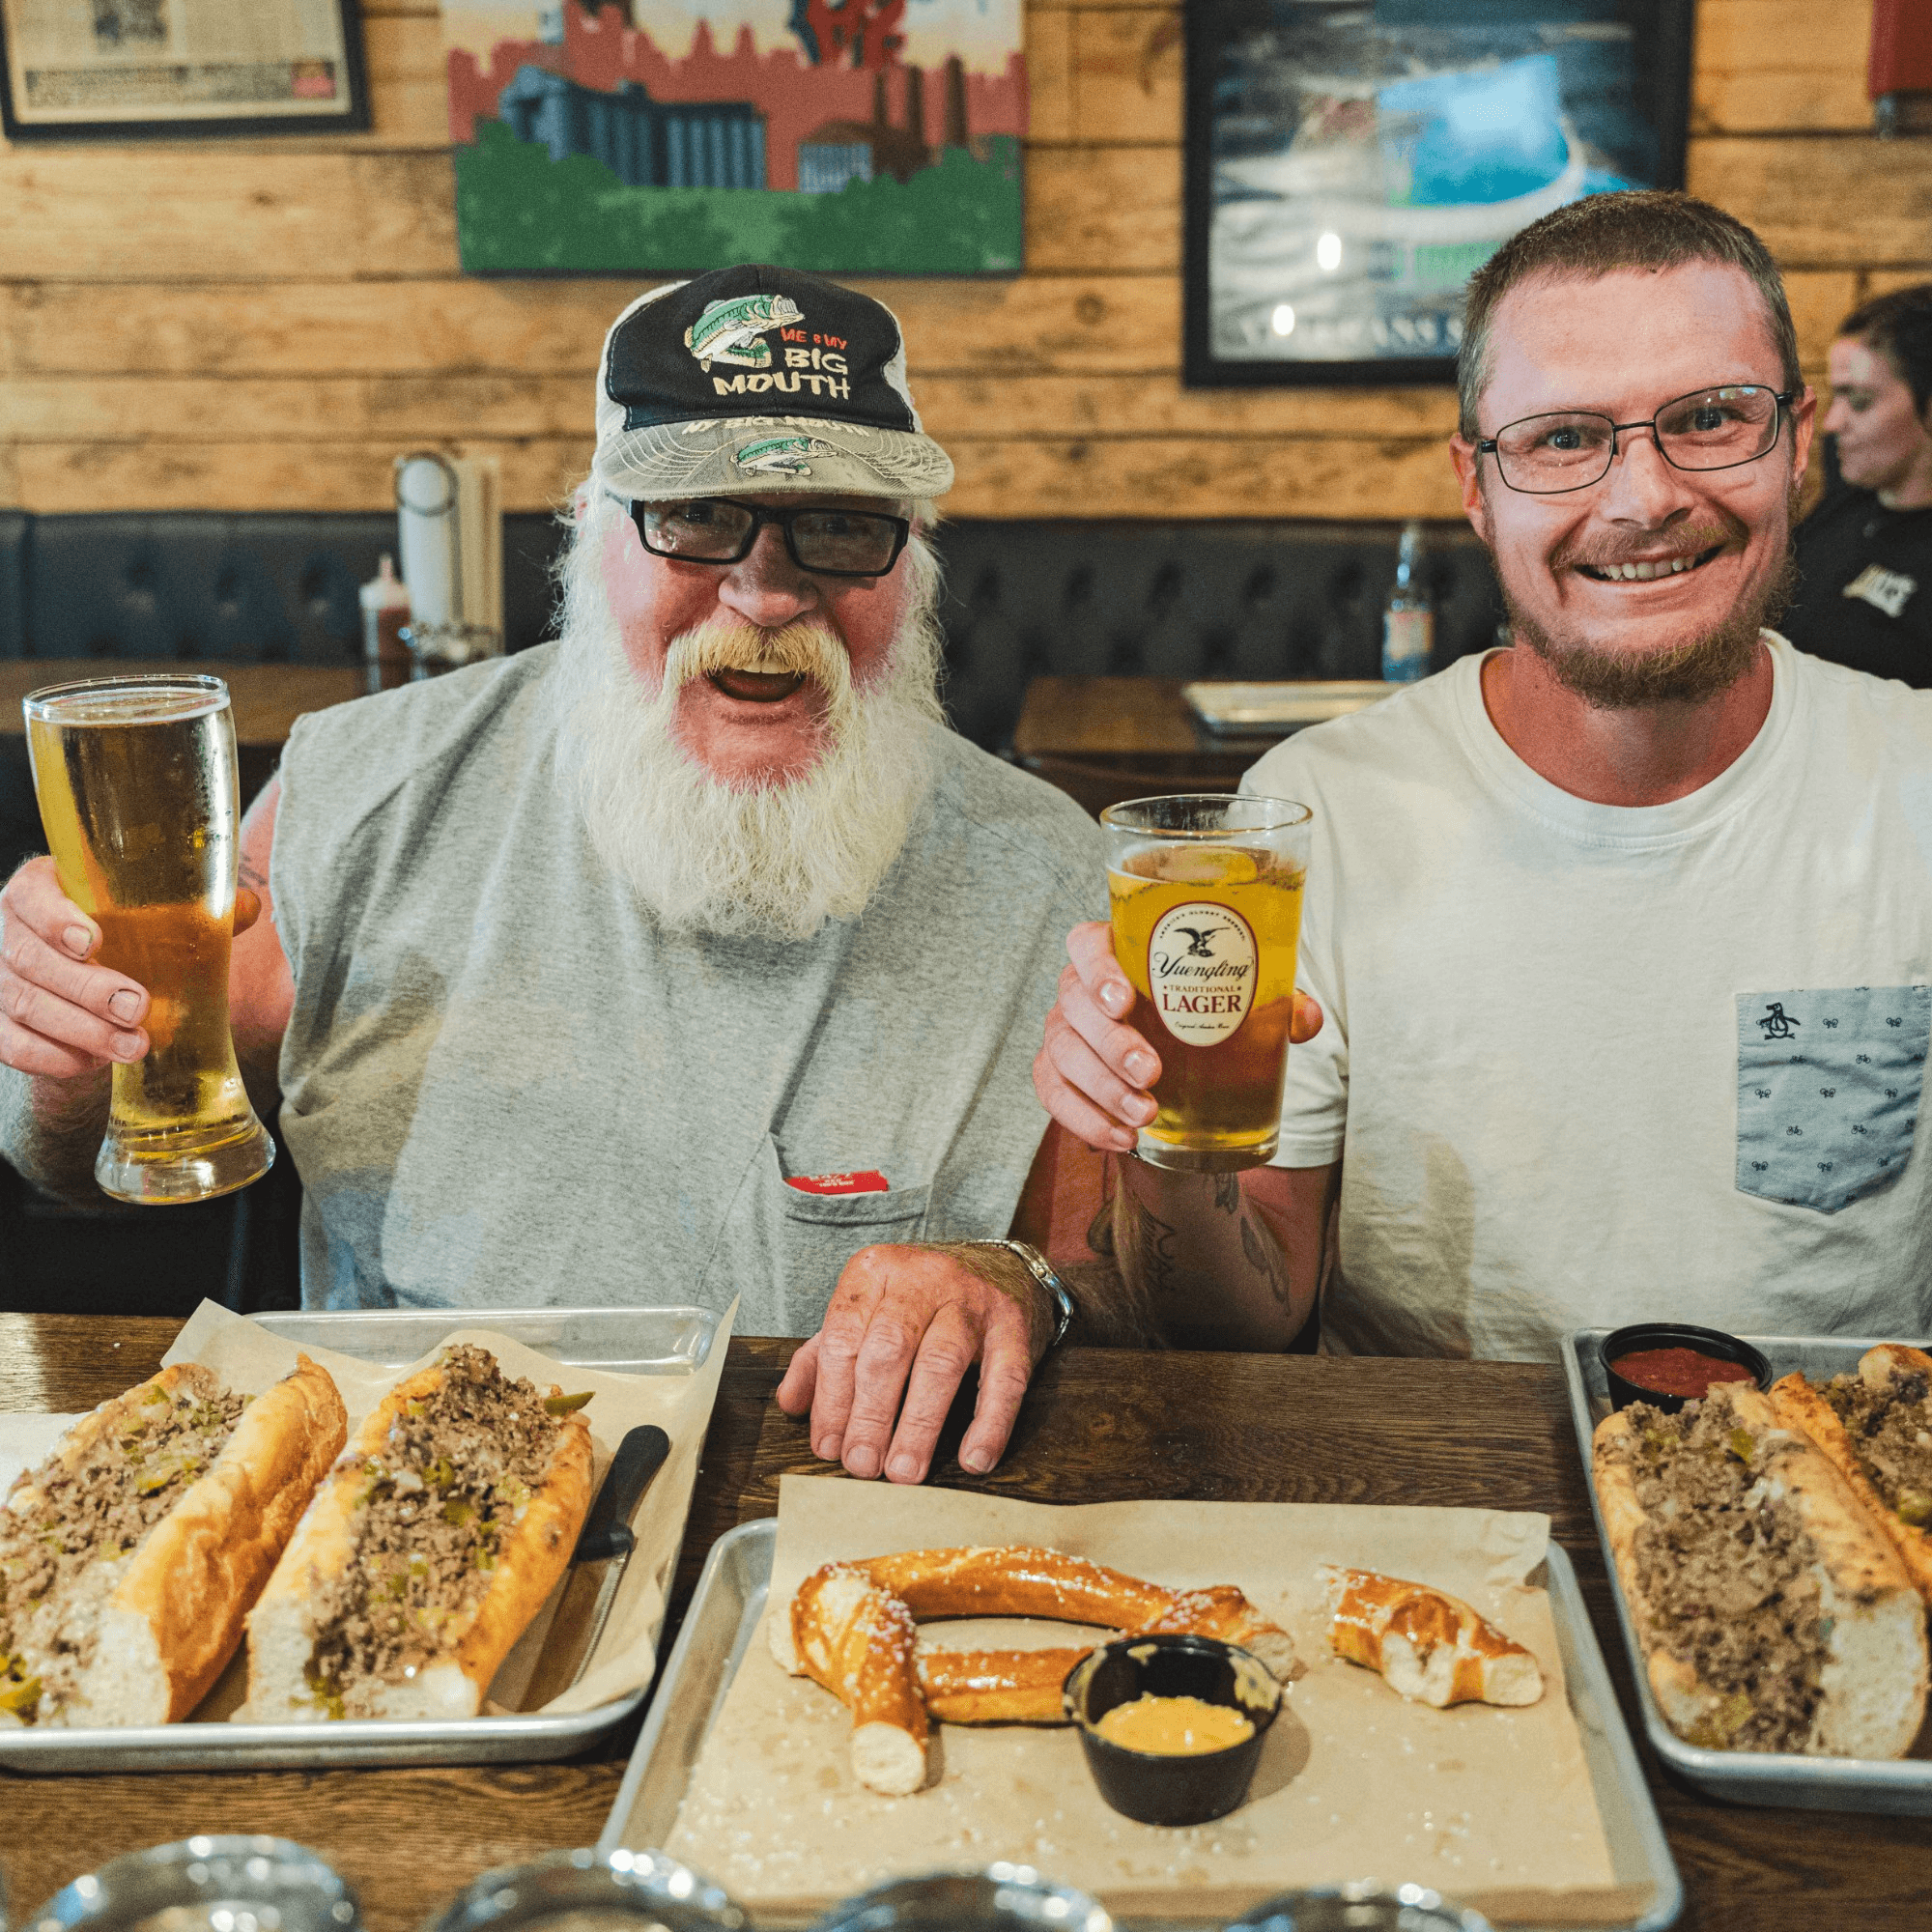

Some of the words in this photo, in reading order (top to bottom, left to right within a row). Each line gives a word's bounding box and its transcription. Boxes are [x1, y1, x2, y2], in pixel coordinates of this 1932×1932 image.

[781, 327, 808, 343] ME
[823, 333, 847, 350] MY
[784, 347, 848, 375] BIG
[712, 370, 851, 400] MOUTH
[1151, 952, 1255, 982] Yuengling
[1170, 984, 1236, 993] TRADITIONAL
[1162, 992, 1242, 1013] LAGER
